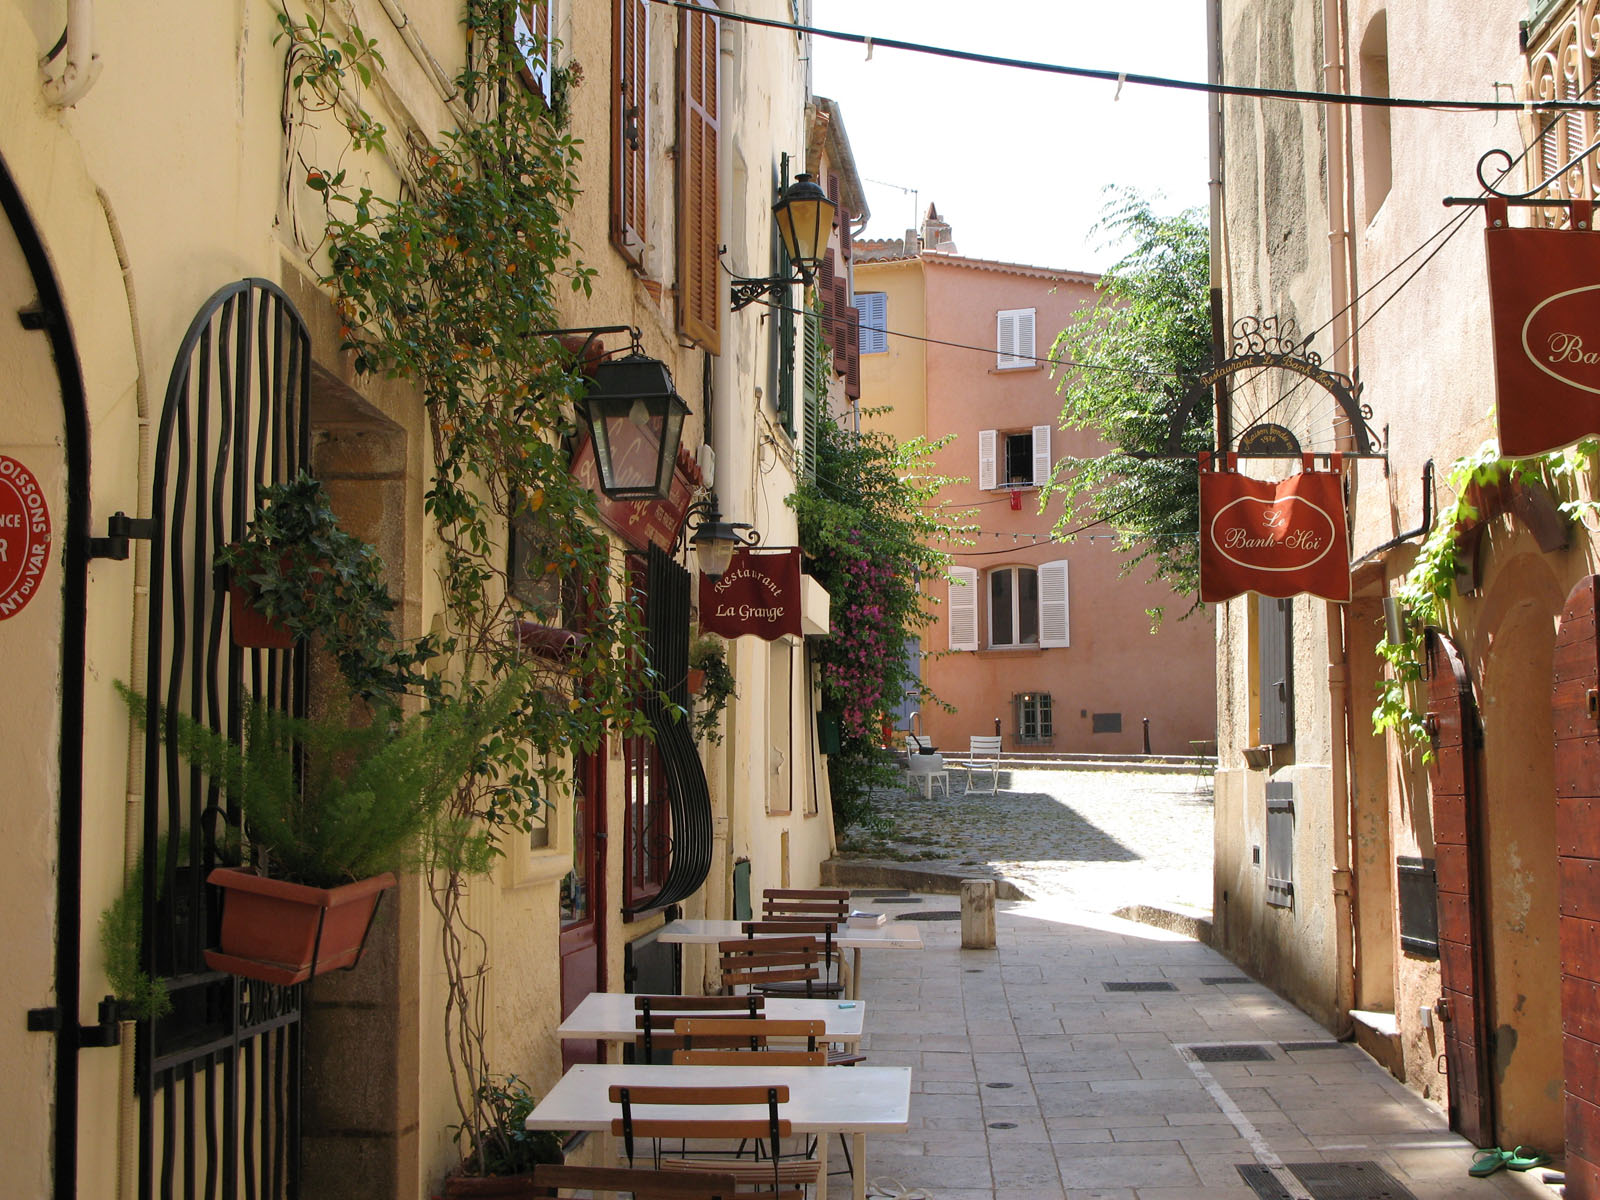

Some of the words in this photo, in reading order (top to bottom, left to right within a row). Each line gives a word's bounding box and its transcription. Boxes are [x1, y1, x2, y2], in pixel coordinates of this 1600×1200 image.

[1200, 357, 1254, 389] Restaurant
[1262, 354, 1275, 365] Le
[1262, 510, 1285, 528] Le
[25, 543, 47, 576] VAR
[20, 577, 35, 595] DU
[714, 569, 783, 598] Restaurant
[715, 604, 736, 617] La
[738, 604, 785, 623] Grange
